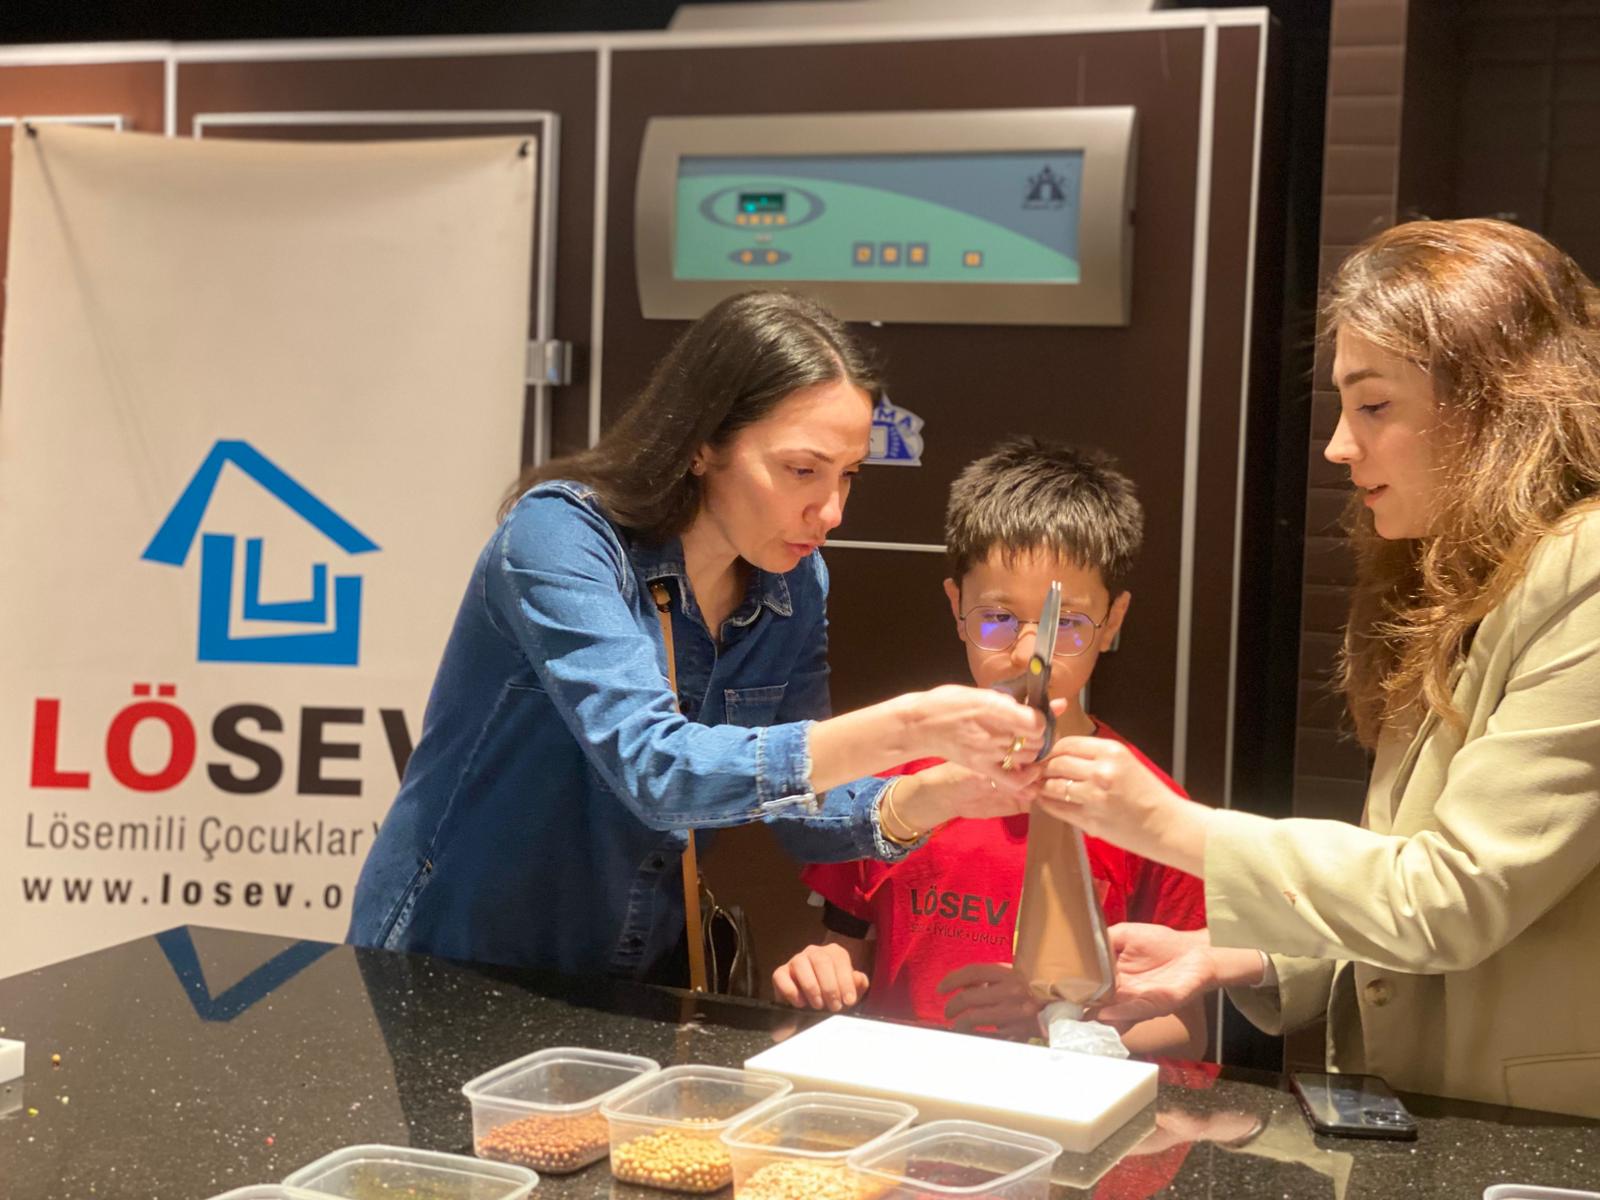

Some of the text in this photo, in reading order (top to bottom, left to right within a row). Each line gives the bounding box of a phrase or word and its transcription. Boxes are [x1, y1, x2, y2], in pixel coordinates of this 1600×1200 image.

[25, 813, 364, 862] Lösemili Çocuklar
[22, 873, 343, 908] www.losev.o
[911, 885, 1010, 926] LÖSEV
[972, 932, 1007, 946] UMUT
